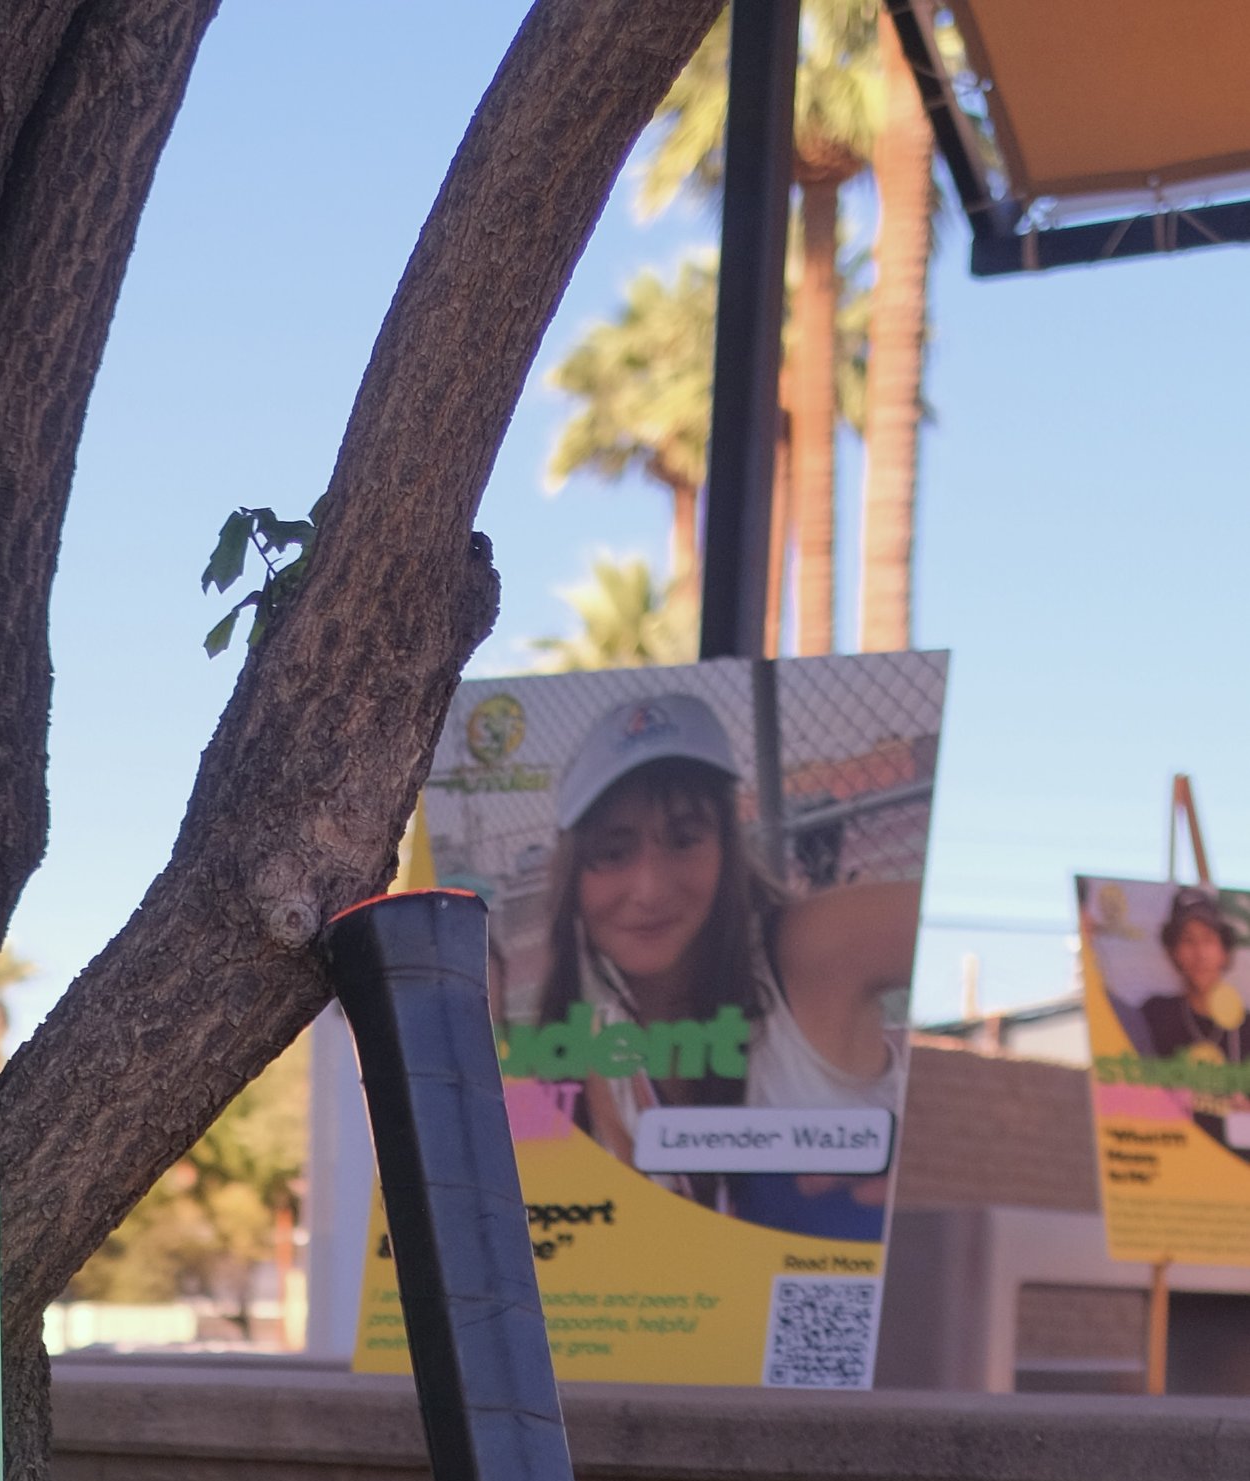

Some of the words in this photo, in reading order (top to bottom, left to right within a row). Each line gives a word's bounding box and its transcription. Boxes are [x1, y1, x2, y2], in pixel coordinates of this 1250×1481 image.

[660, 1126, 783, 1149] Lavender
[791, 1126, 879, 1149] Walsh
[784, 1254, 827, 1271] Read
[833, 1256, 875, 1271] More
